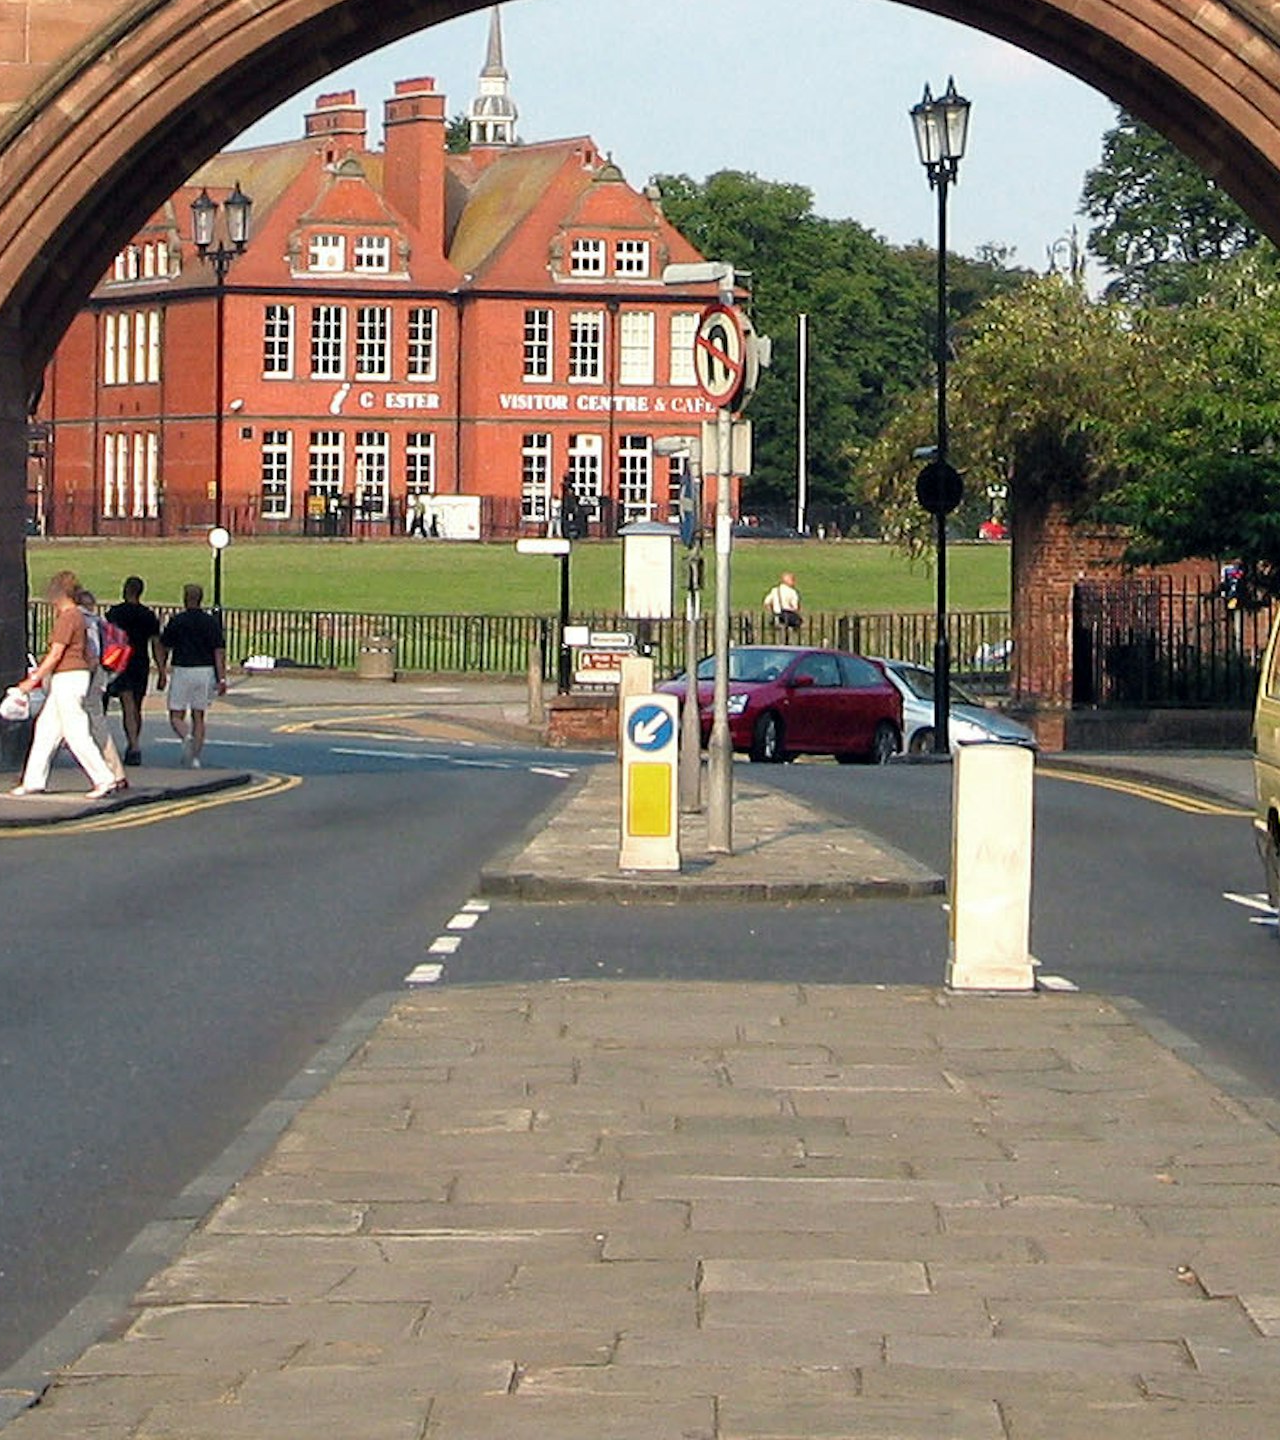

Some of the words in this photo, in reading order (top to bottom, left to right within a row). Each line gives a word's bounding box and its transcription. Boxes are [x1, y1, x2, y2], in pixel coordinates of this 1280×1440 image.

[500, 394, 569, 410] VISITOR
[576, 395, 649, 412] CENTRE
[654, 397, 667, 412] &
